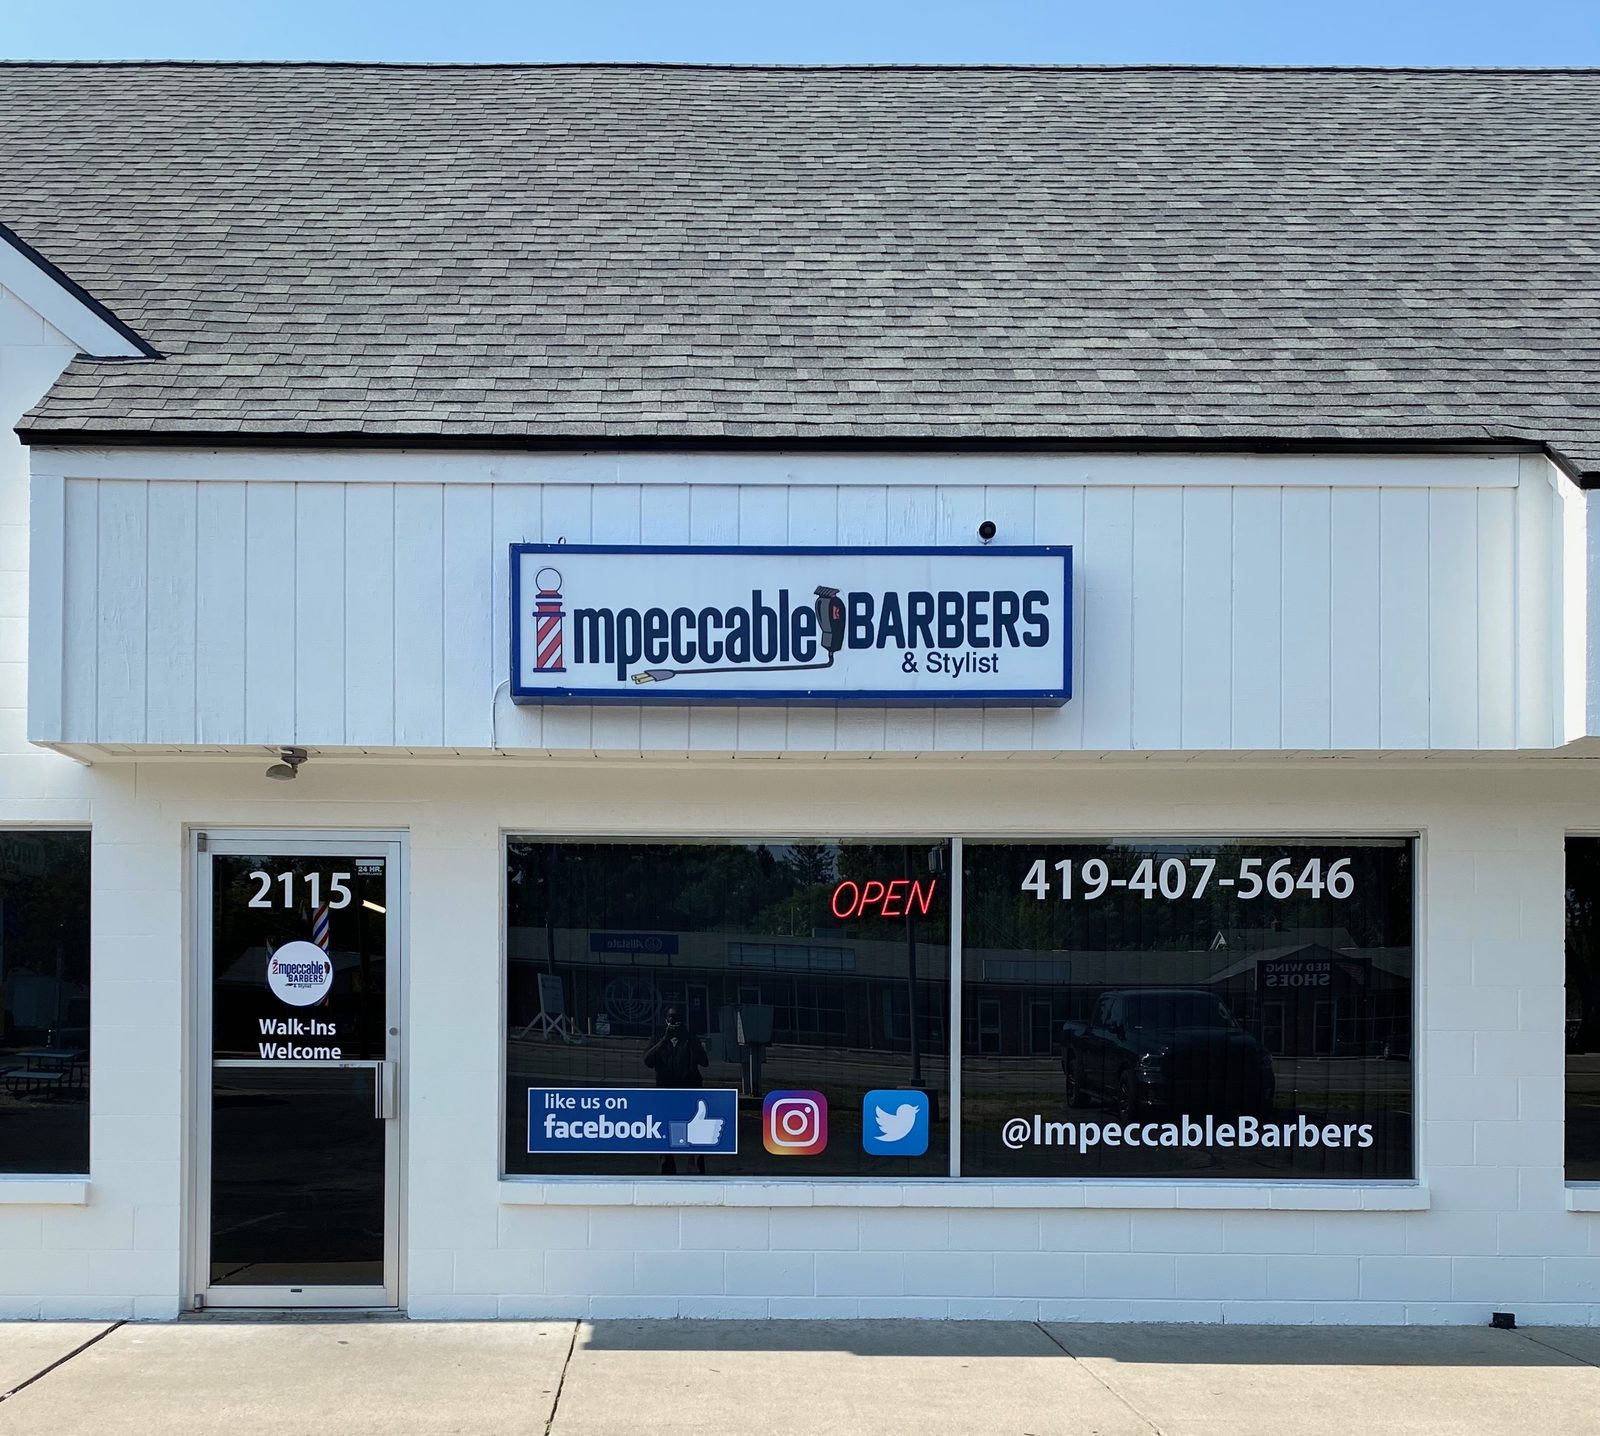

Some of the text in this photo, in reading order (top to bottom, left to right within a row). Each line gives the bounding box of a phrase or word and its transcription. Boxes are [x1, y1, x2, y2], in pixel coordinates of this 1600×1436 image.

[848, 591, 1049, 649] BARBERS
[902, 651, 999, 679] & Stylist
[248, 871, 352, 909] 2115
[1021, 858, 1355, 900] 419-407-5646
[832, 880, 936, 918] OPEN
[288, 975, 324, 983] BARBERS
[258, 1018, 337, 1036] Walk-Ins
[258, 1042, 342, 1060] Welcome
[544, 1093, 628, 1109] like us on
[544, 1114, 662, 1139] facebook
[1002, 1114, 1374, 1154] @ImpeccableBarbers
